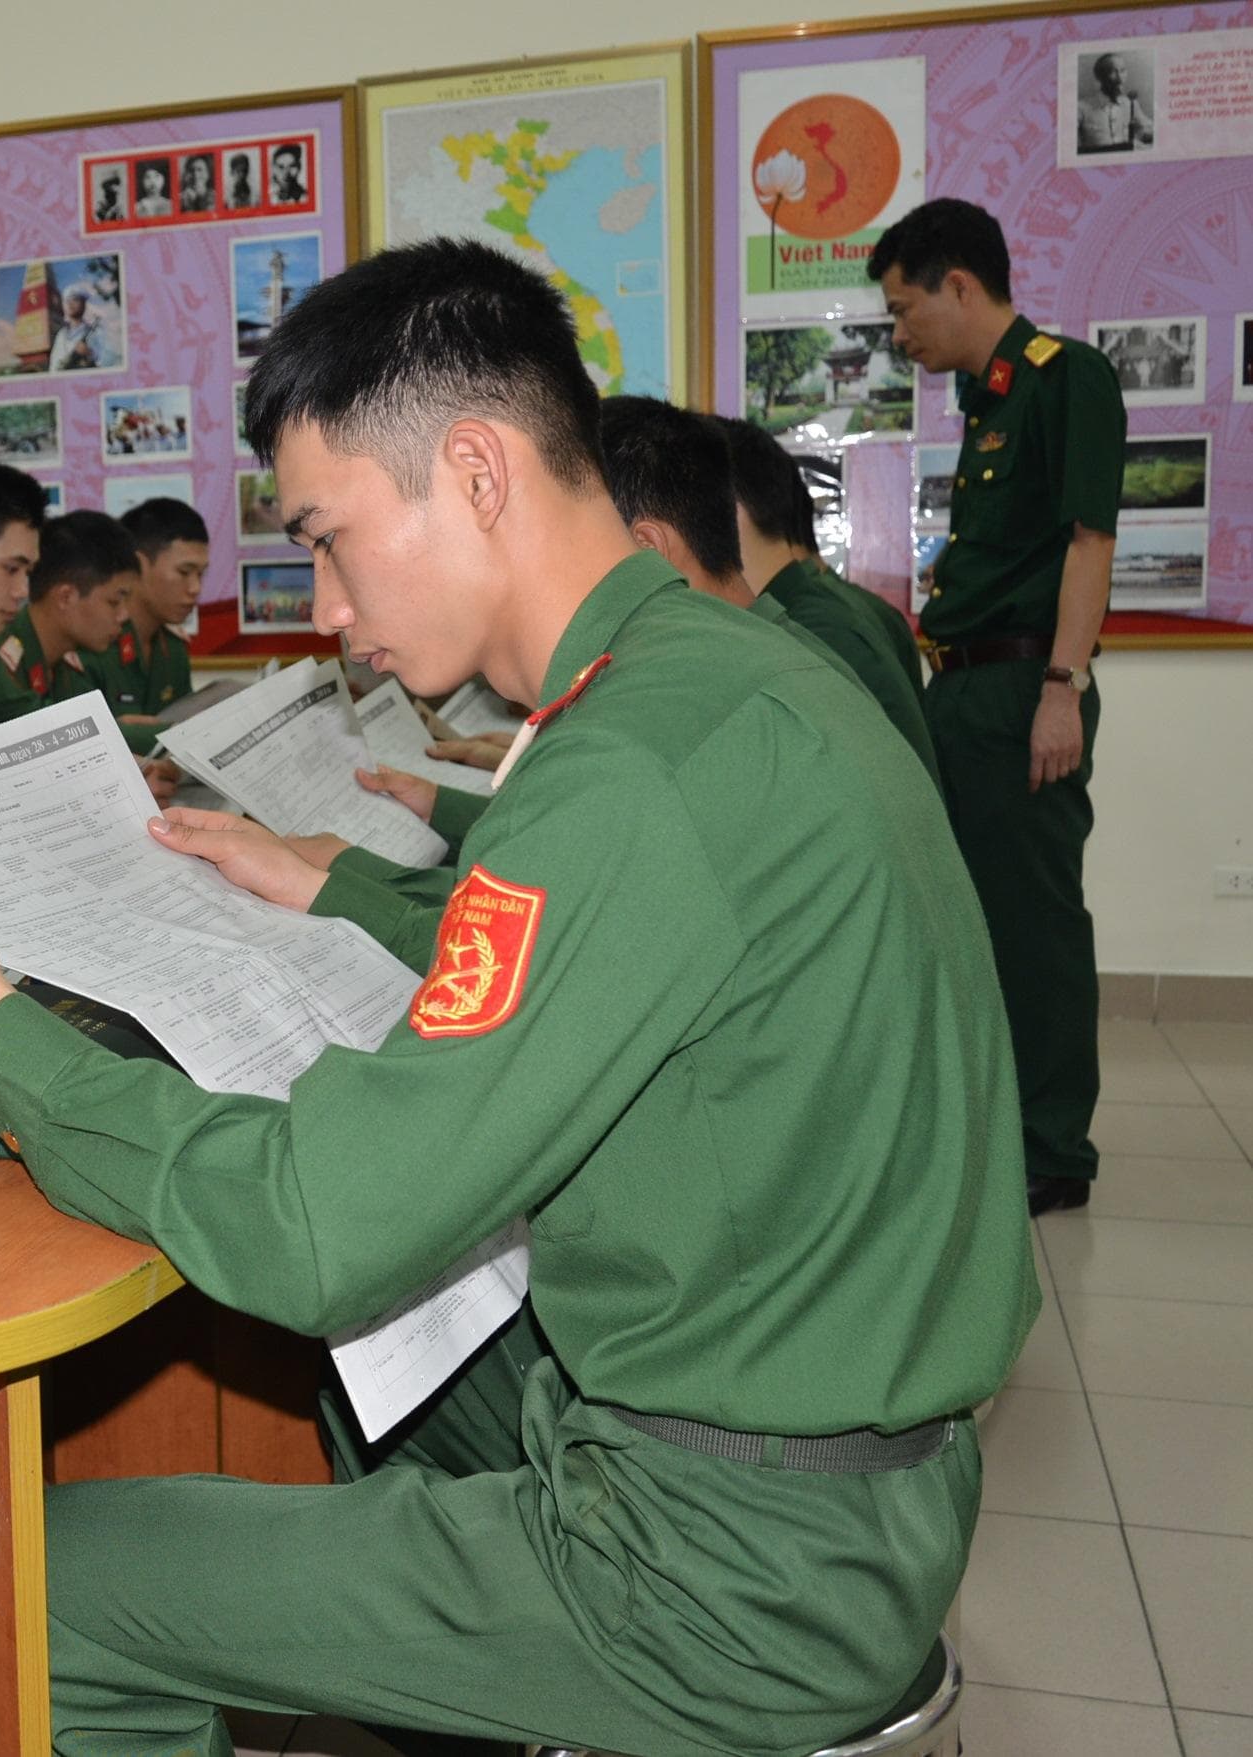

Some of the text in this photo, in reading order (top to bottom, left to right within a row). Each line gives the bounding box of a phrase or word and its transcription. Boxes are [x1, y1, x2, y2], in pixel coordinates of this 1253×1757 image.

[9, 746, 33, 762] ngày
[31, 740, 45, 753] 28
[52, 734, 60, 746] 4
[65, 723, 90, 741] 2016
[468, 892, 500, 911] NHÂN
[462, 909, 492, 926] NAM
